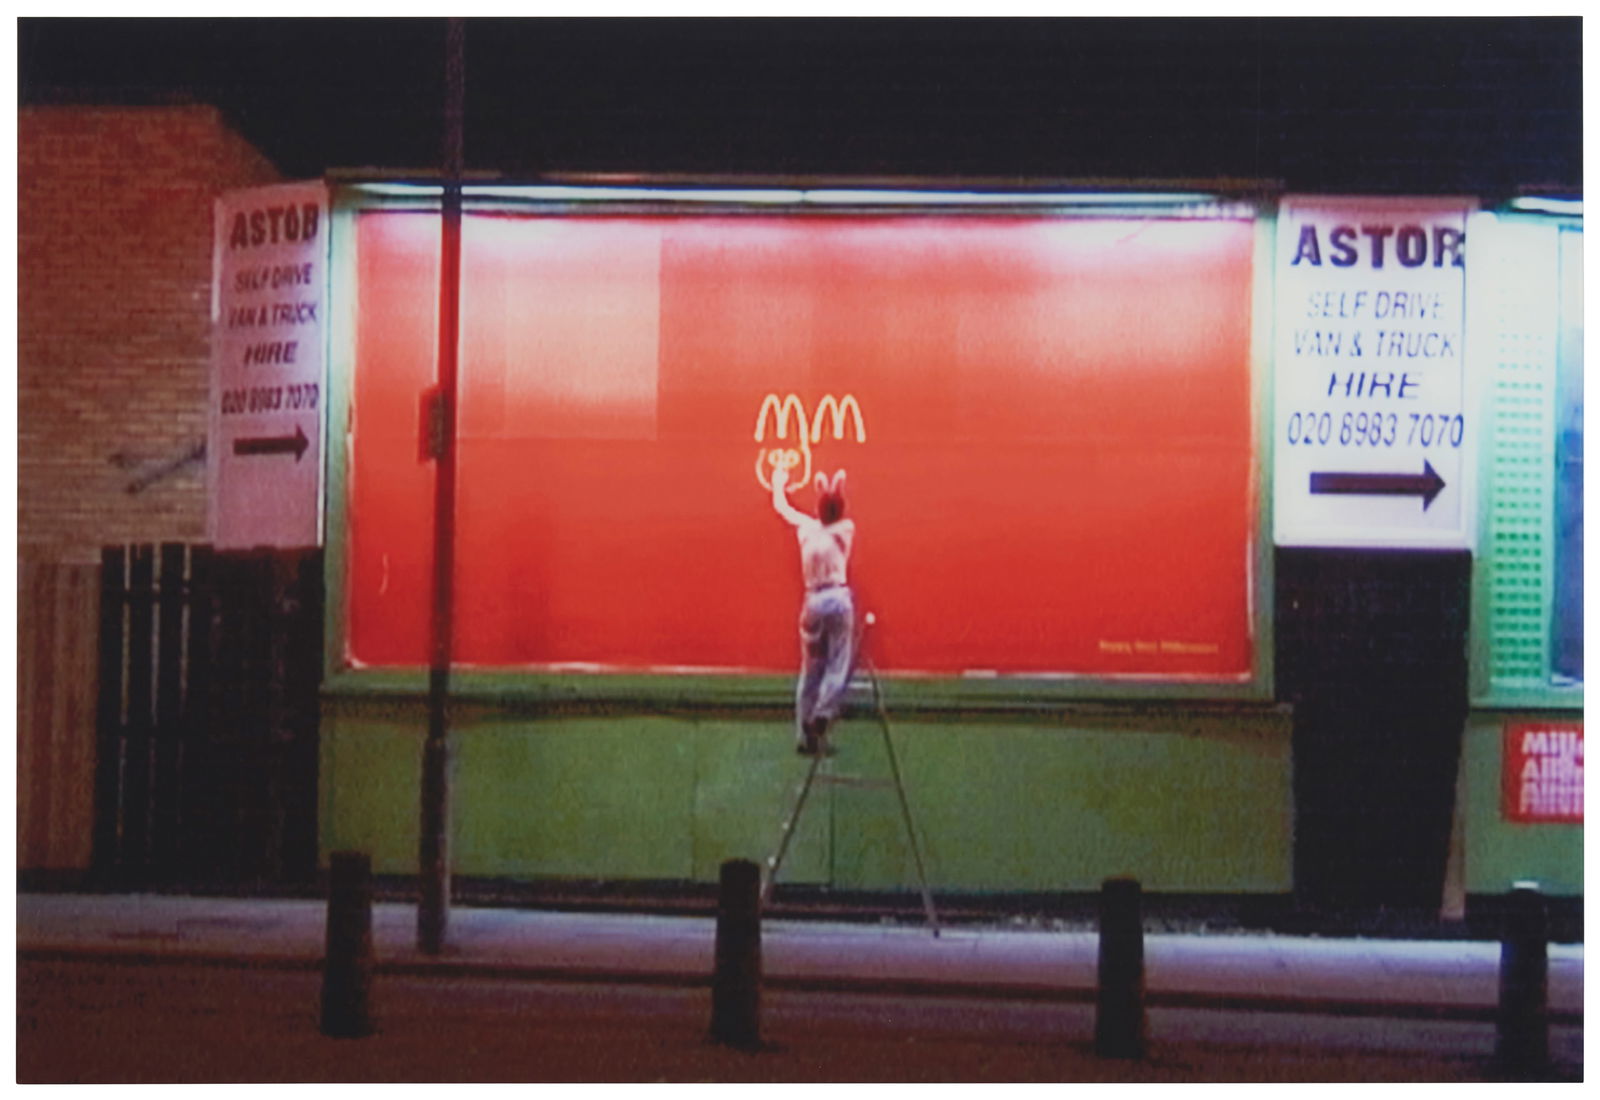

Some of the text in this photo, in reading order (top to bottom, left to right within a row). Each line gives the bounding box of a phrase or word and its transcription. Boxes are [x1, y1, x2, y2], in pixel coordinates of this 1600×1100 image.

[1291, 224, 1465, 269] ASTOR
[1307, 290, 1444, 319] SELF DRIVE
[243, 341, 298, 367] HIRE
[1295, 330, 1342, 356] VAN
[1376, 331, 1456, 357] TRUCK
[285, 382, 320, 410] 7070
[1327, 372, 1423, 398] HIRE
[1288, 411, 1464, 448] 020 8983 7070
